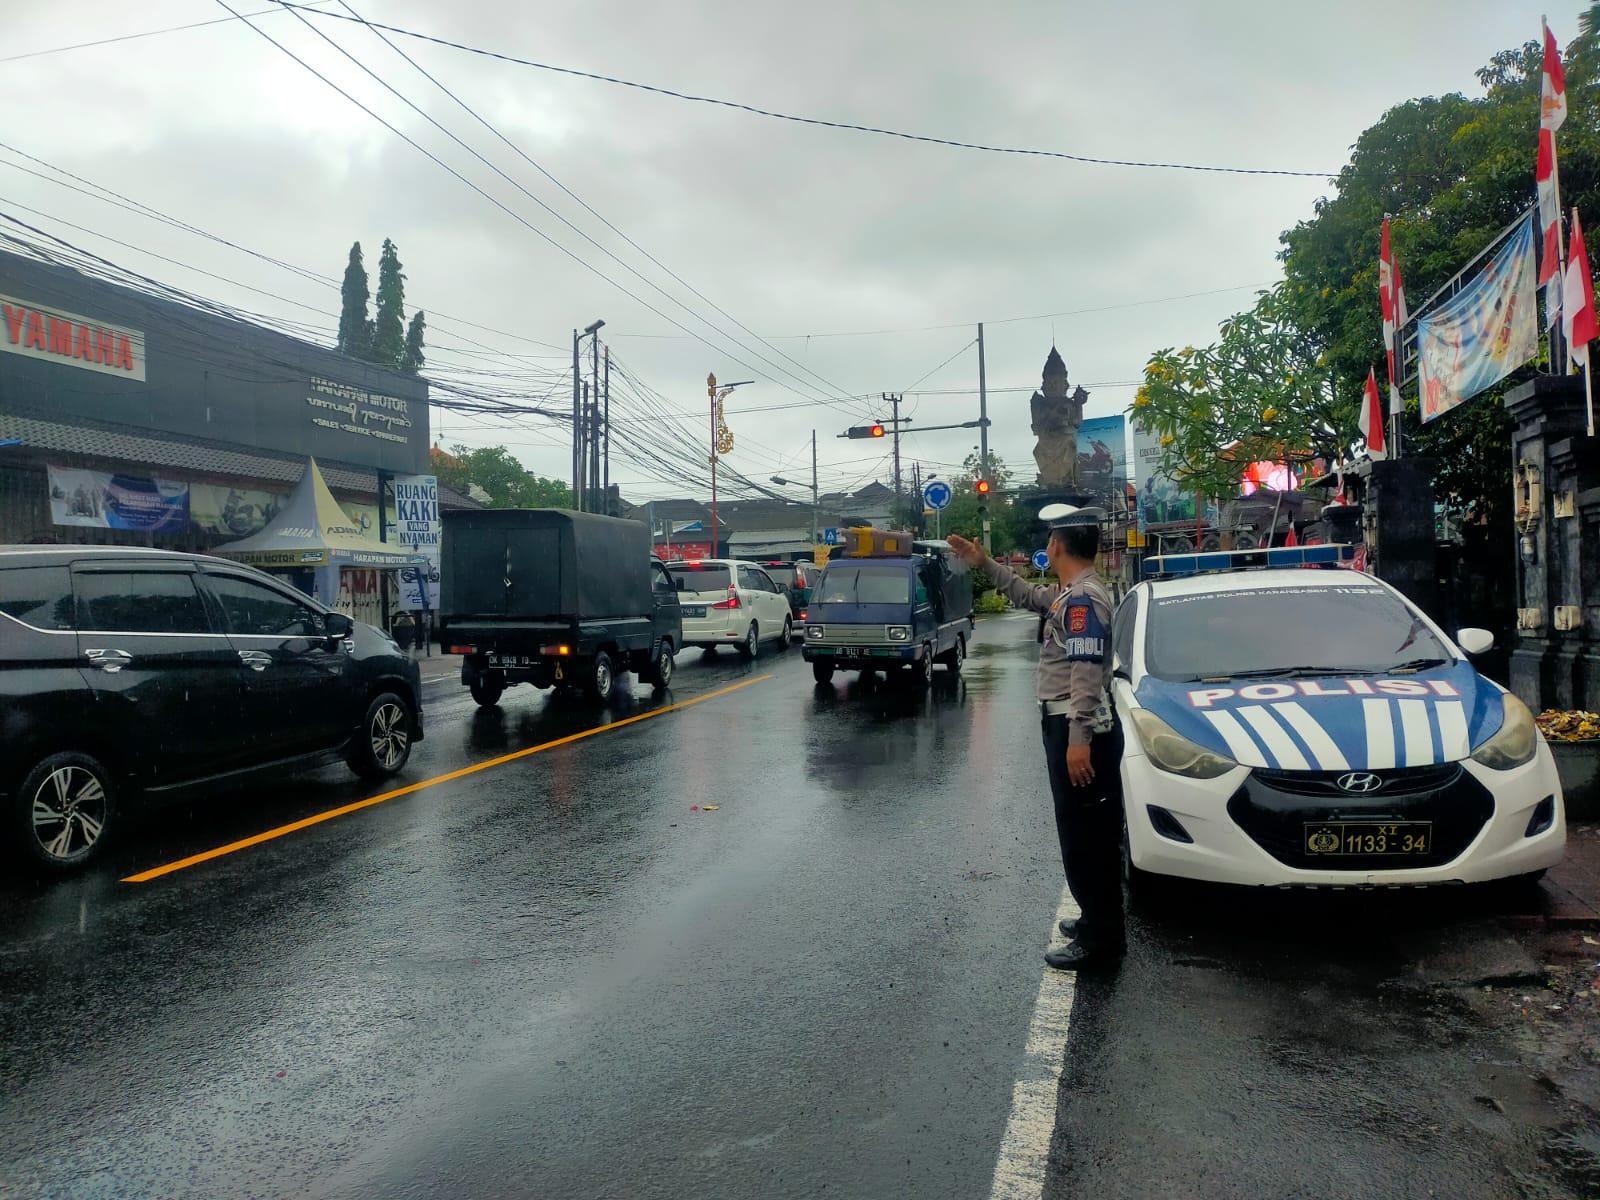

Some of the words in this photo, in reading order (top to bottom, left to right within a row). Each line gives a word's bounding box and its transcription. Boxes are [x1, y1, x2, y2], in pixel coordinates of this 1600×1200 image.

[3, 303, 133, 370] YAMAHA
[397, 484, 436, 500] RUANG
[398, 500, 437, 520] KAKI
[408, 522, 428, 530] YANG
[400, 533, 438, 544] NYAMAN
[264, 554, 295, 563] MOTOR
[1188, 679, 1460, 708] POLISI
[1346, 835, 1386, 852] 1133
[1402, 834, 1425, 851] 34
